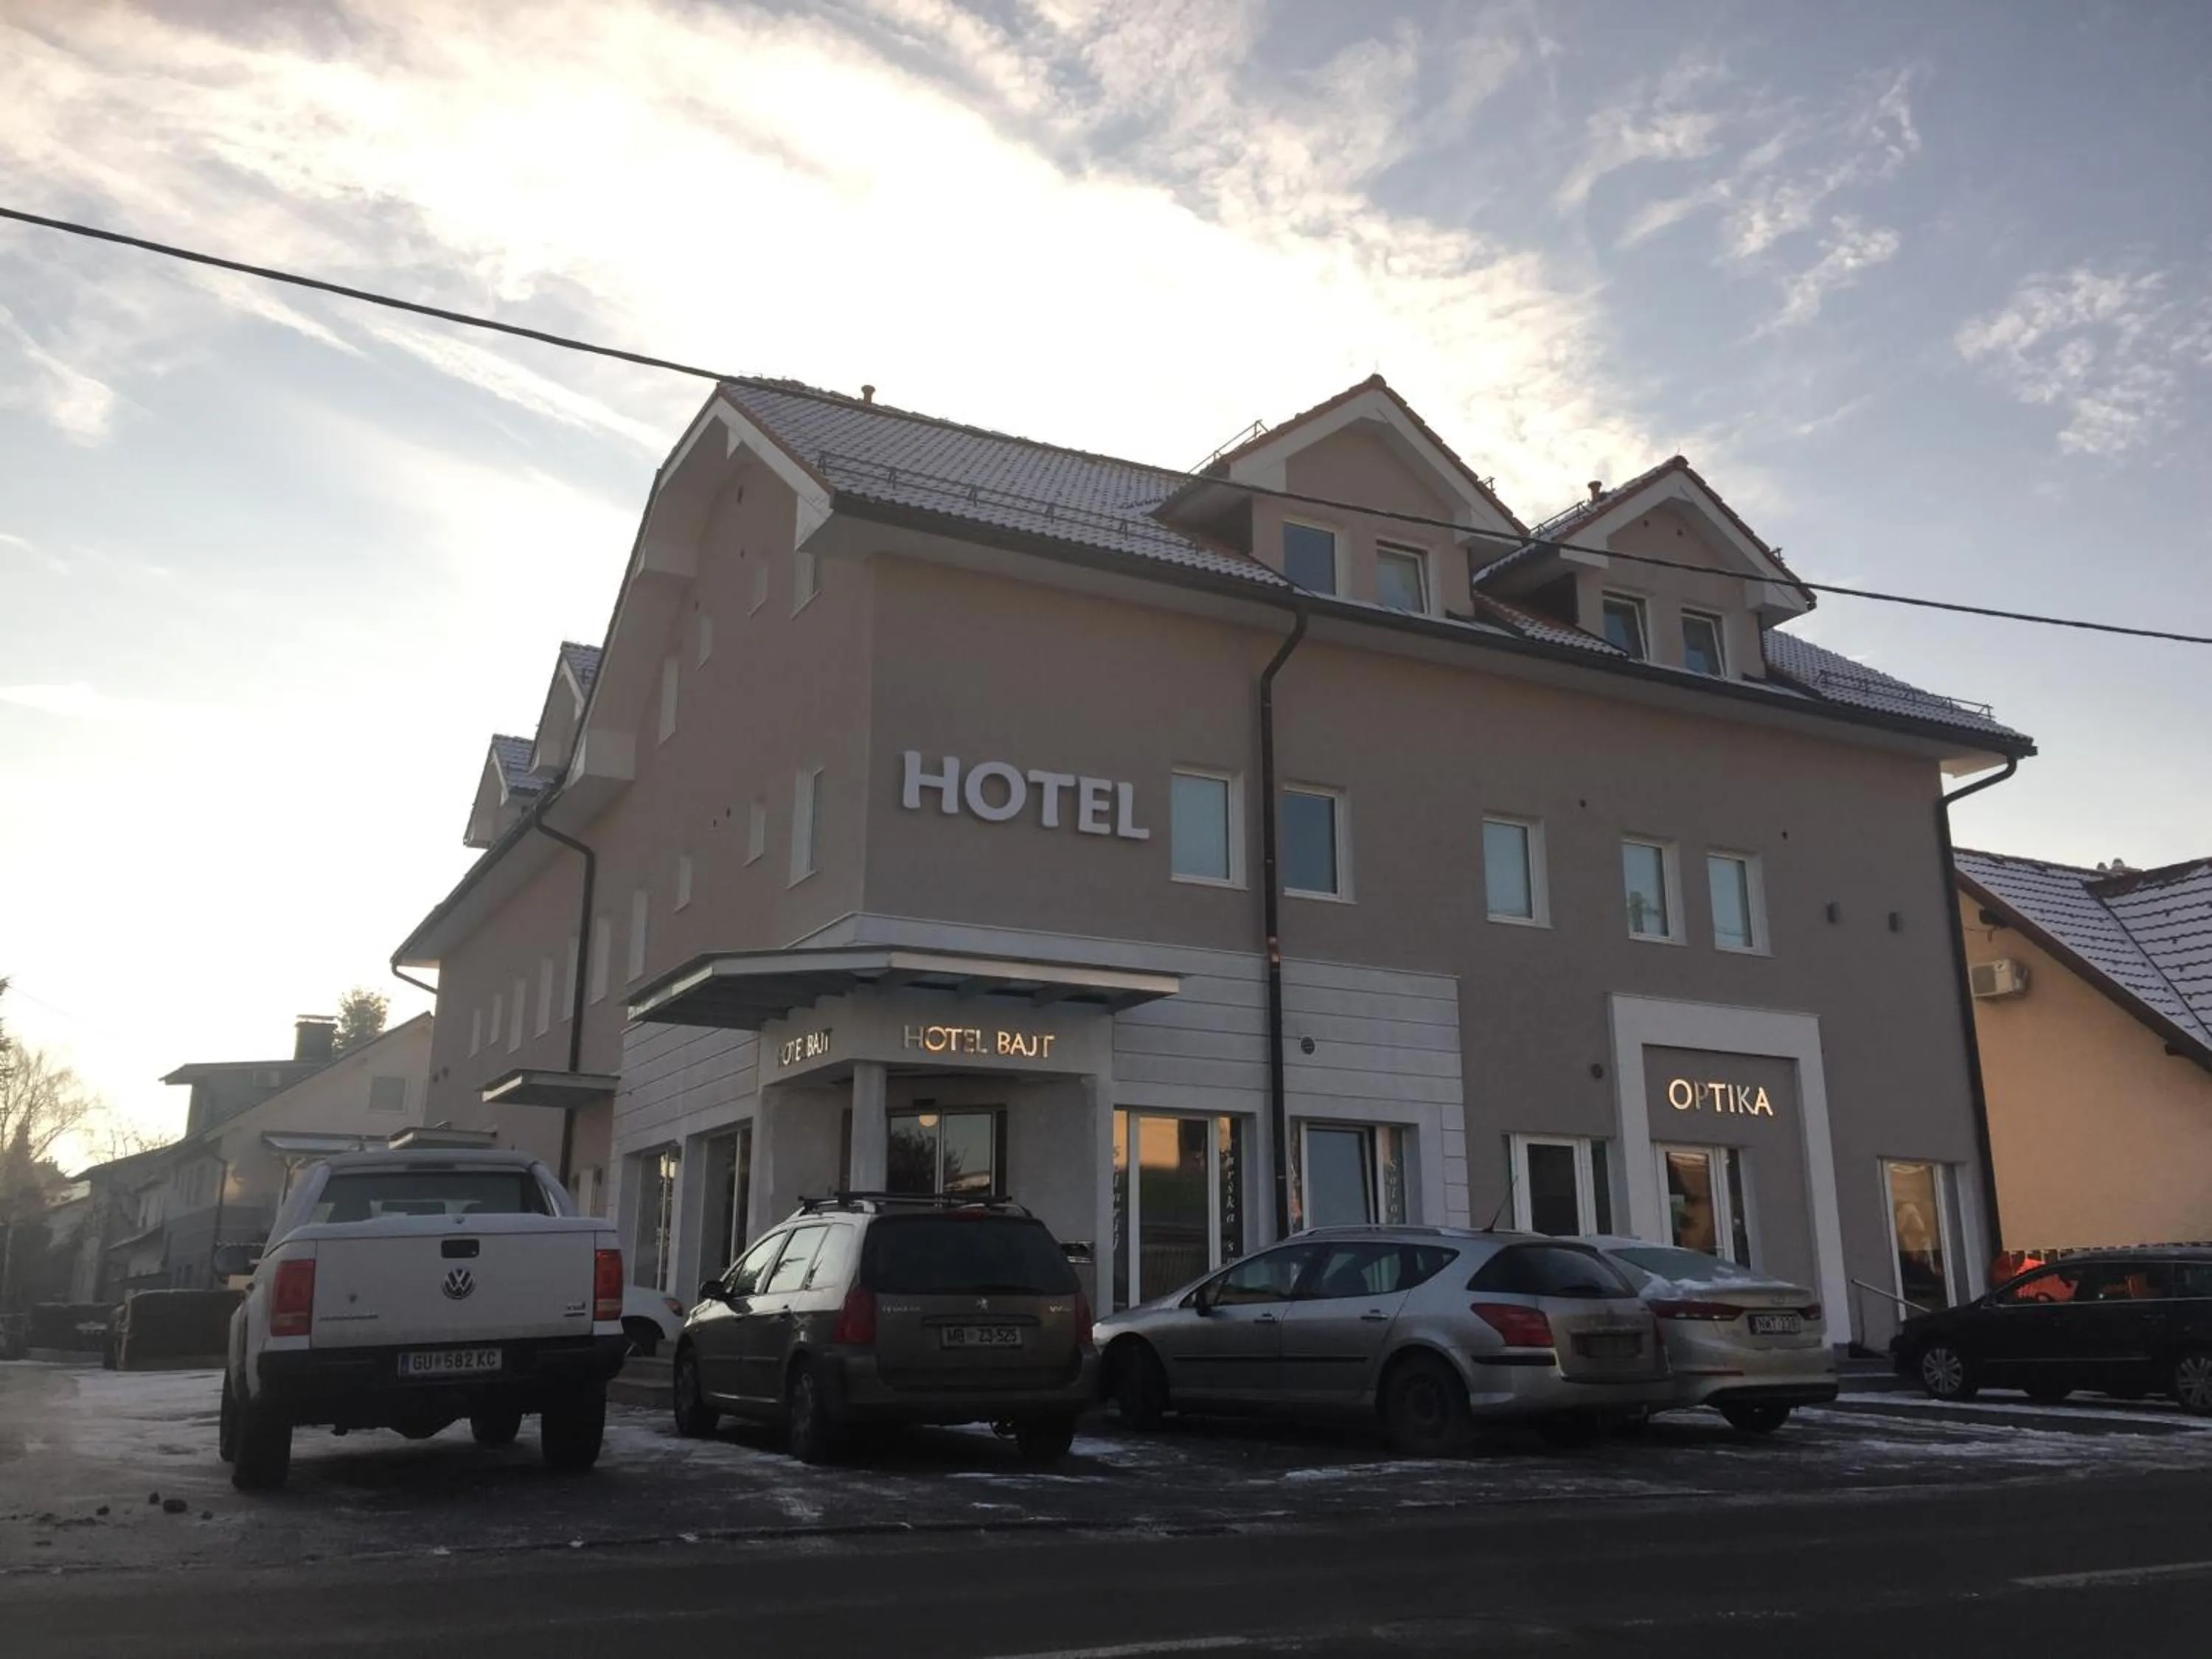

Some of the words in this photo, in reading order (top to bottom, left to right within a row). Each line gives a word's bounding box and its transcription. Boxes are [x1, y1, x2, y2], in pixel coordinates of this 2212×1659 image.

[902, 750, 1150, 840] HOTEL
[903, 1025, 988, 1054] HOTEL
[997, 1030, 1055, 1058] BAJT
[1668, 1079, 1773, 1116] OPTIKA
[413, 1354, 433, 1370] GU
